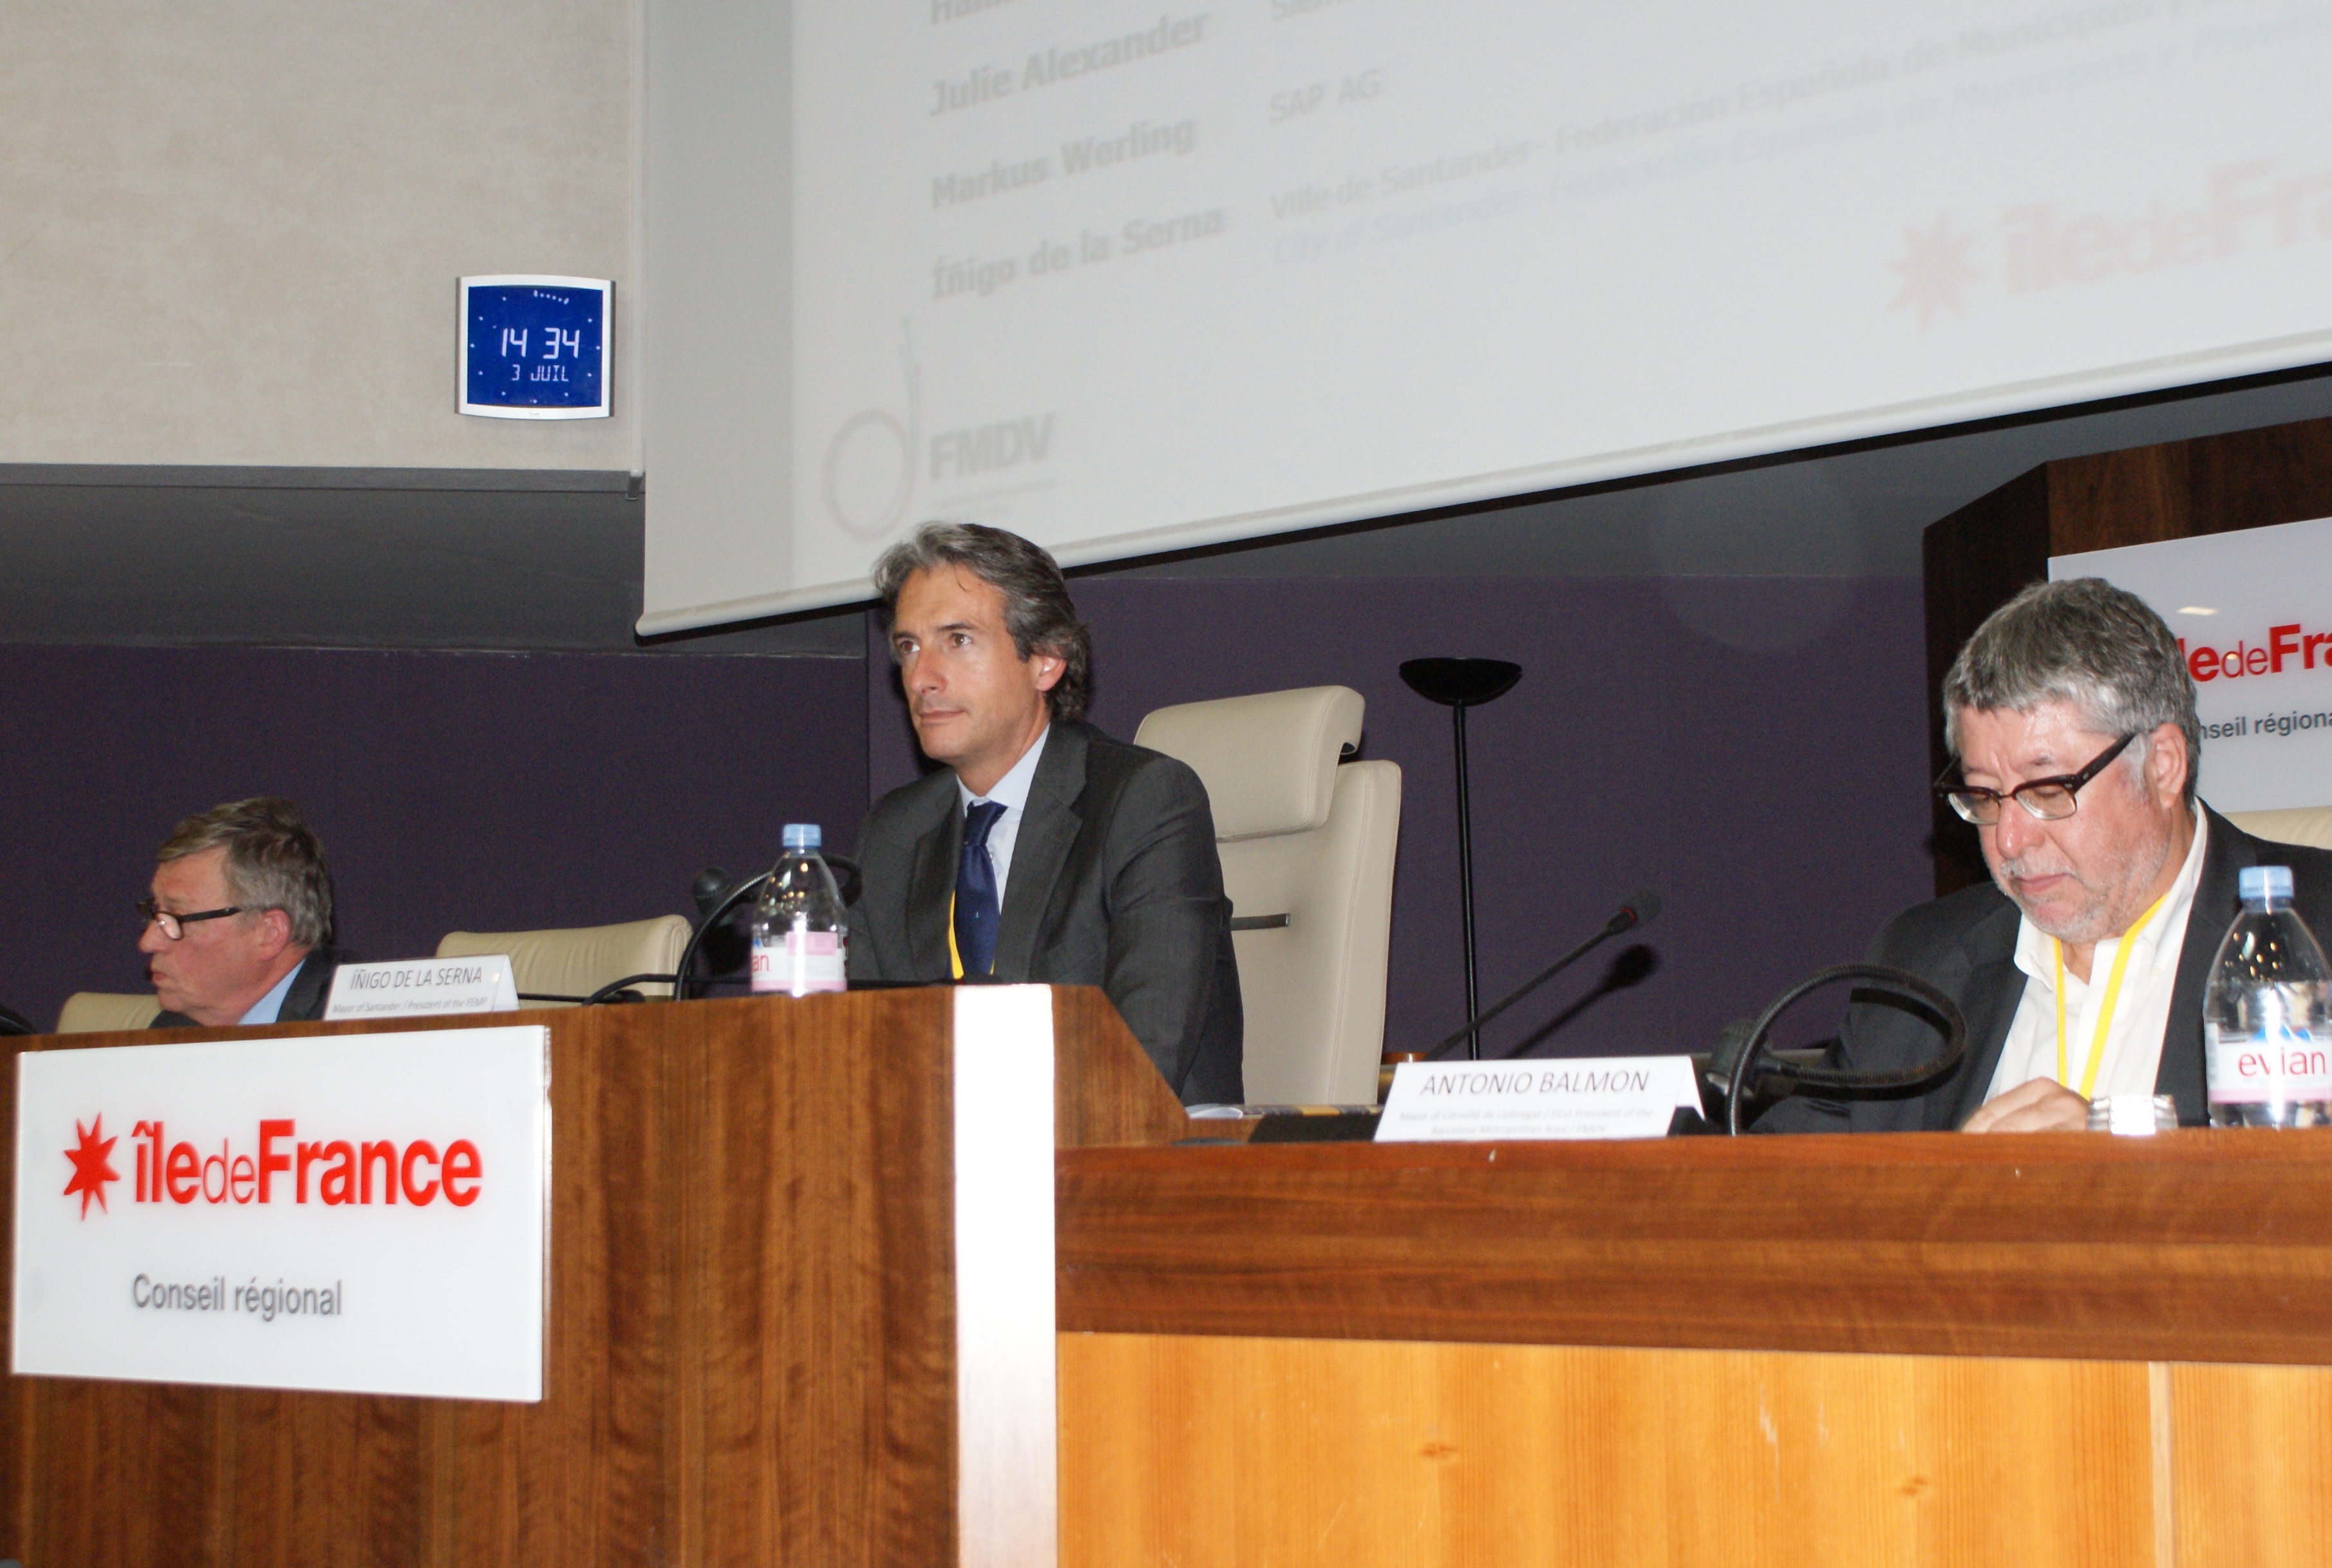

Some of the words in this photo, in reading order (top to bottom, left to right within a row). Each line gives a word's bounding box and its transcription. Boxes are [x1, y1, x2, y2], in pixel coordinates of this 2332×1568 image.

[929, 64, 1014, 118] Julie
[1020, 10, 1213, 91] Alexander
[1268, 81, 1328, 126] SAP
[1335, 66, 1386, 107] AG
[1269, 182, 1331, 223] Ville
[1335, 174, 1374, 207] de
[1380, 138, 1532, 197] Santander
[1555, 87, 1732, 156] Federación
[1901, 37, 1948, 74] de
[930, 155, 1053, 212] Markus
[1058, 118, 1201, 178] Werling
[1028, 237, 1071, 277] de
[1078, 227, 1111, 266] la
[1119, 205, 1228, 256] Serna
[1372, 186, 1521, 245] Santander
[501, 328, 528, 358] 14
[542, 327, 581, 360] 34
[511, 363, 521, 382] 3
[530, 364, 569, 382] JUIL
[929, 409, 1058, 481] FMDV
[350, 968, 391, 990] ÍÑIGO
[394, 969, 414, 988] DE
[416, 969, 433, 987] LA
[436, 966, 483, 985] SERNA
[365, 1002, 402, 1013] Santander
[408, 1000, 443, 1011] President
[1420, 1072, 1533, 1095] ANTONIO
[1539, 1069, 1650, 1093] BALMON
[131, 1117, 484, 1208] îledeFrance
[132, 1272, 226, 1311] Conseil
[234, 1276, 343, 1323] régional
